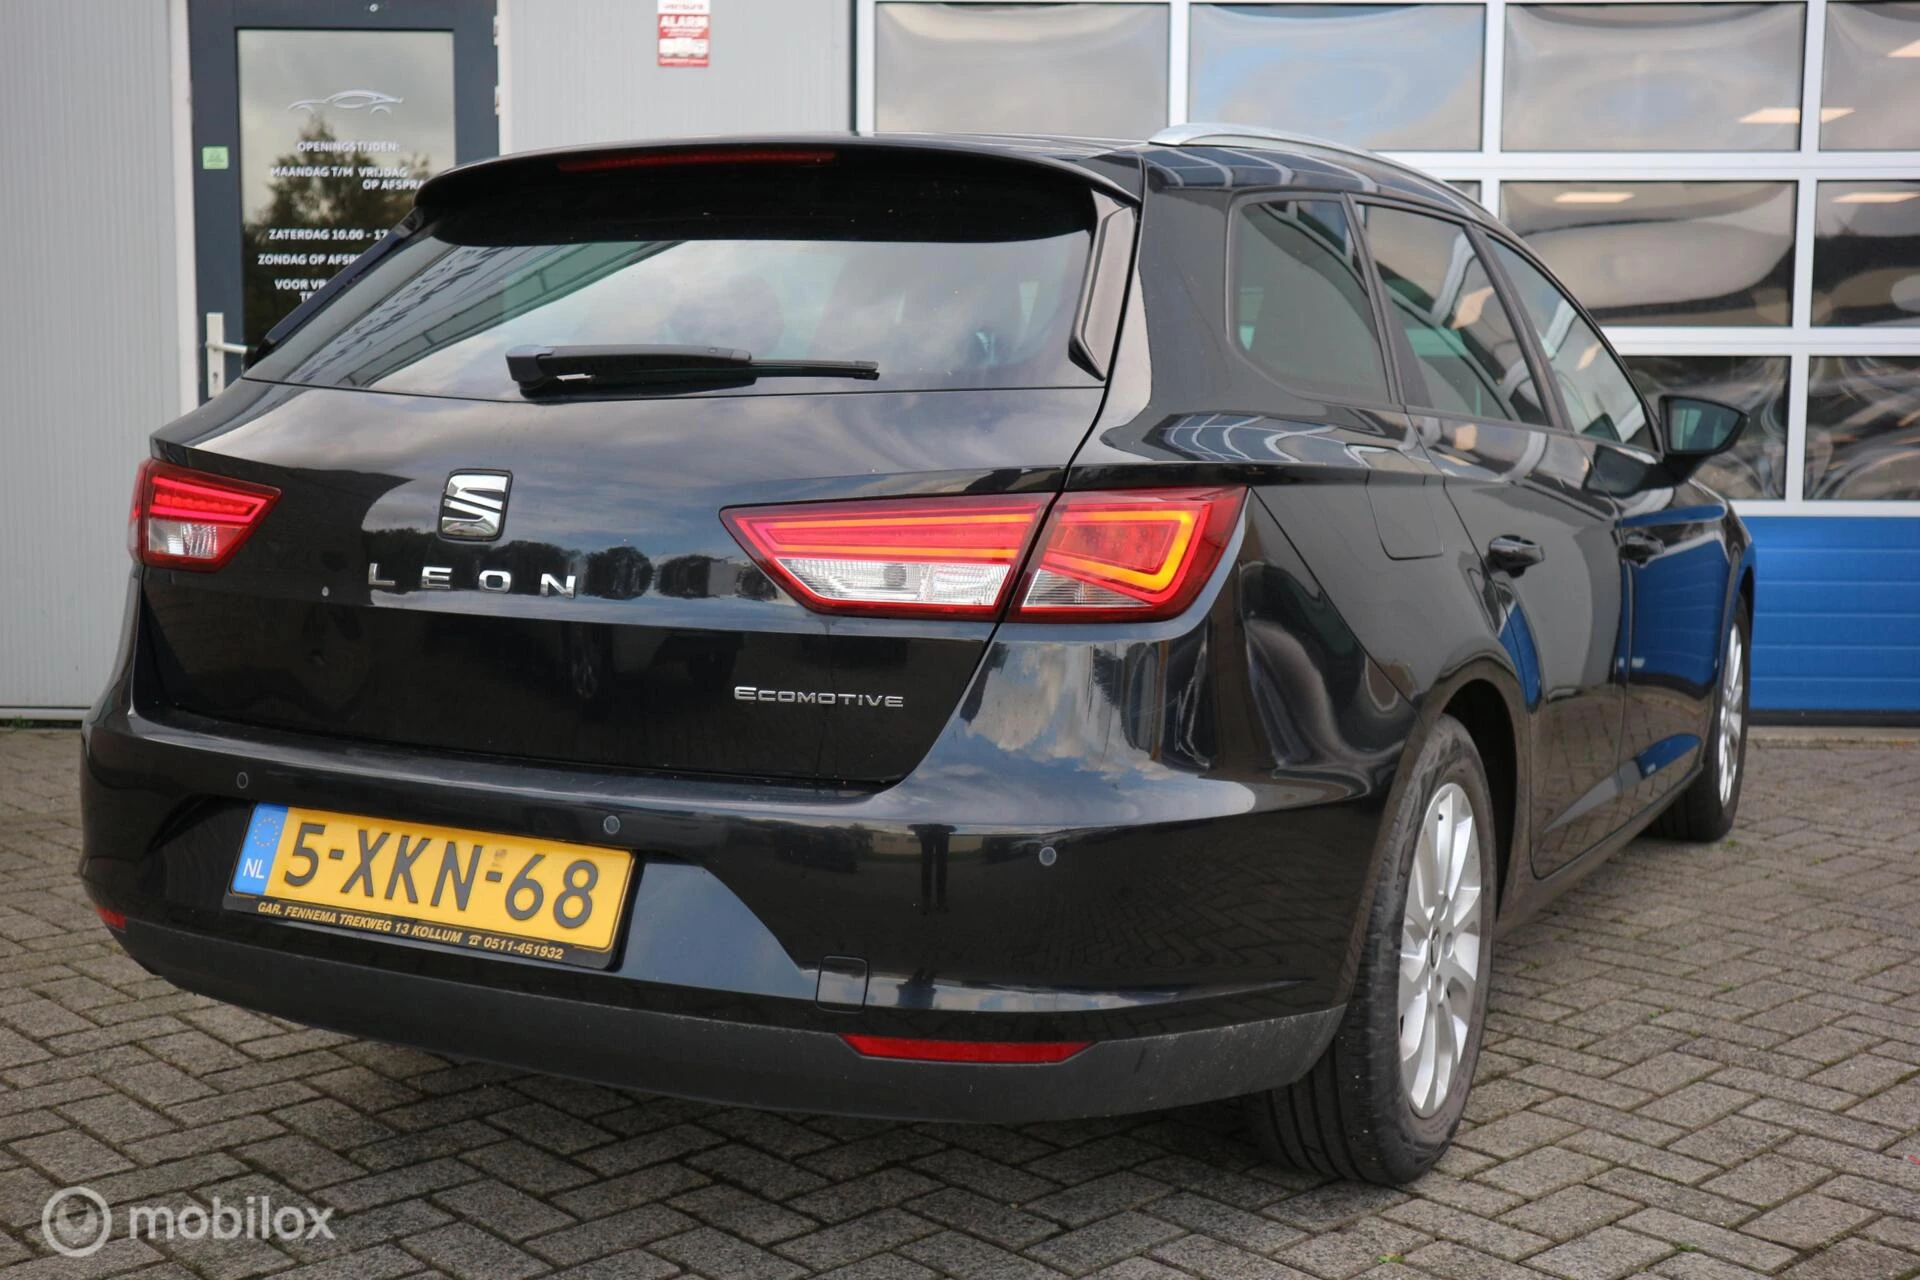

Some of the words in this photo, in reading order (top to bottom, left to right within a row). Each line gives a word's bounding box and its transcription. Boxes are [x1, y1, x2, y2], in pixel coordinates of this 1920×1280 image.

[296, 141, 400, 152] OPENINGSTIJDEN:
[271, 167, 329, 178] MAANDAG
[331, 167, 353, 178] T/M
[358, 167, 408, 178] VRIJDAG
[362, 179, 380, 190] OP
[268, 229, 330, 240] ZATERDAG
[332, 229, 364, 240] 10.00
[258, 254, 307, 265] ZONDAG
[309, 254, 327, 265] OP
[275, 279, 308, 290] VOOR
[368, 563, 576, 599] LEON
[242, 858, 265, 879] NL
[284, 822, 599, 929] 5-XKN-68
[257, 902, 282, 916] GAR.
[284, 906, 336, 924] FENNEMA
[339, 914, 392, 931] TREKWEG
[395, 922, 409, 935] 13
[411, 925, 463, 944] KOLLUM
[483, 937, 564, 960] 0511-451932
